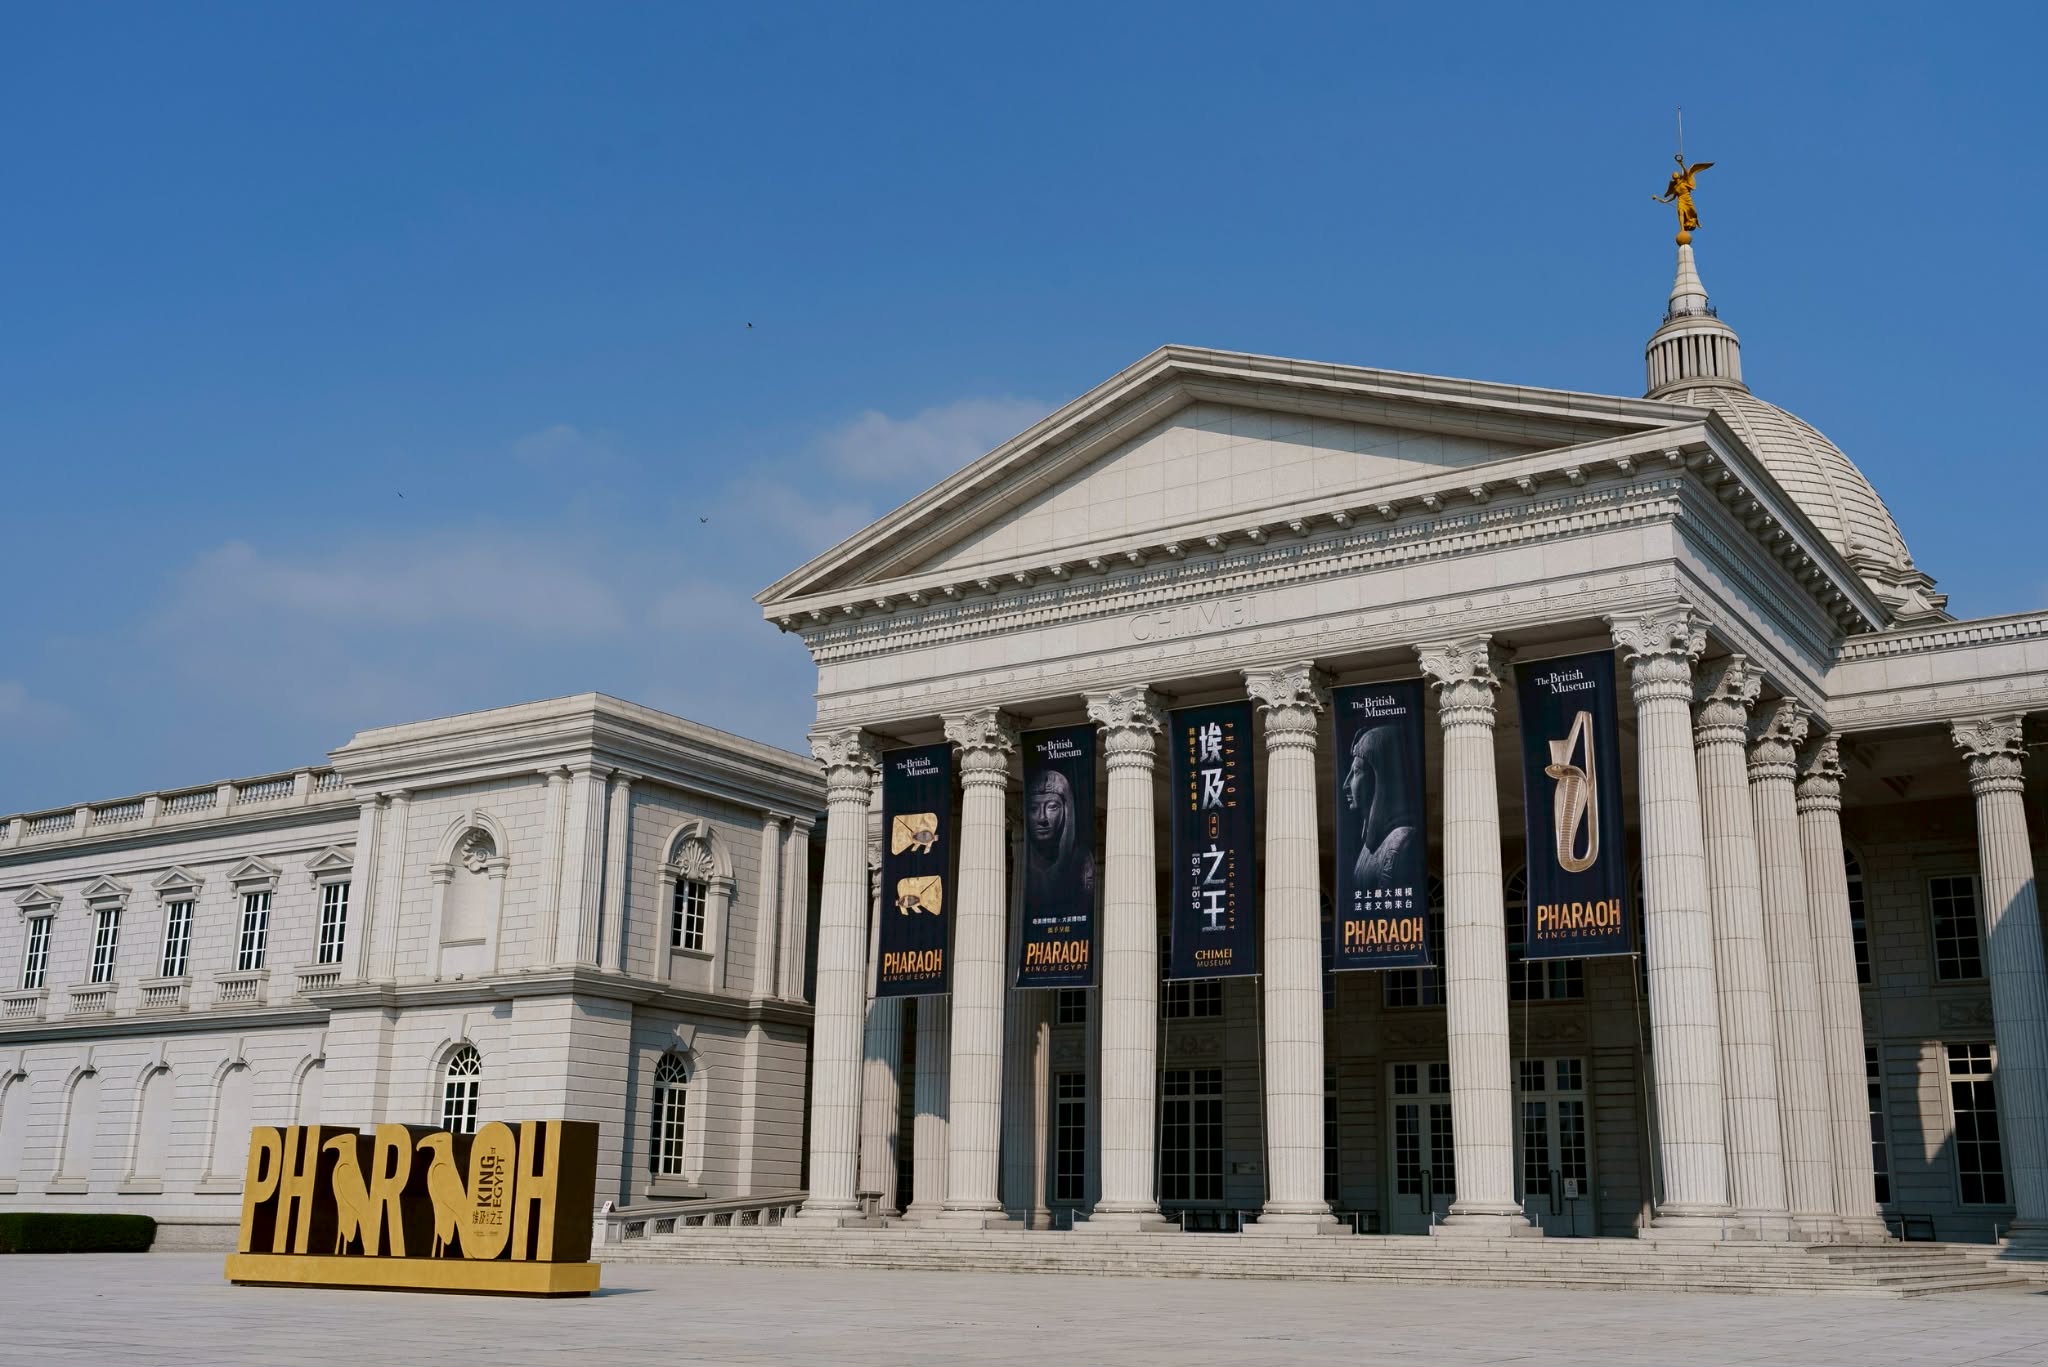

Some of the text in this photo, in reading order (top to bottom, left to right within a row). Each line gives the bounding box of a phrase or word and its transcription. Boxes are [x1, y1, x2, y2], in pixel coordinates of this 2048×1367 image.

[1129, 596, 1258, 641] CHIMEI
[1535, 669, 1584, 686] The British
[1551, 680, 1596, 694] Museum
[1364, 695, 1396, 708] British
[1365, 706, 1407, 718] Museum
[1036, 739, 1073, 752] The British
[1048, 749, 1082, 760] Museum
[906, 756, 931, 768] British
[1224, 723, 1237, 808] PHARAOH
[906, 767, 939, 777] Museum
[1191, 857, 1201, 865] 01
[1191, 868, 1201, 876] 29
[1191, 890, 1201, 898] 01
[1354, 887, 1413, 899] 史上最大規模
[1191, 901, 1201, 910] 10
[1354, 899, 1413, 911] 法老文物來台
[1537, 899, 1621, 931] PHARAOH
[1344, 917, 1423, 945] PHARAOH
[1537, 930, 1567, 939] KING
[1582, 926, 1621, 936] EGYPT
[1026, 940, 1089, 966] PHARAOH
[1344, 945, 1373, 954] KING
[1386, 943, 1423, 952] EGYPT
[1195, 949, 1233, 961] CHIMEI
[884, 949, 942, 975] PHARAOH
[1025, 965, 1048, 973] KING
[1058, 963, 1088, 971] EGYPT
[1196, 959, 1232, 968] MUSEUM
[883, 974, 904, 982] KING
[914, 971, 942, 980] EGYPT
[477, 1155, 496, 1208] KING
[492, 1155, 505, 1208] EGYPT
